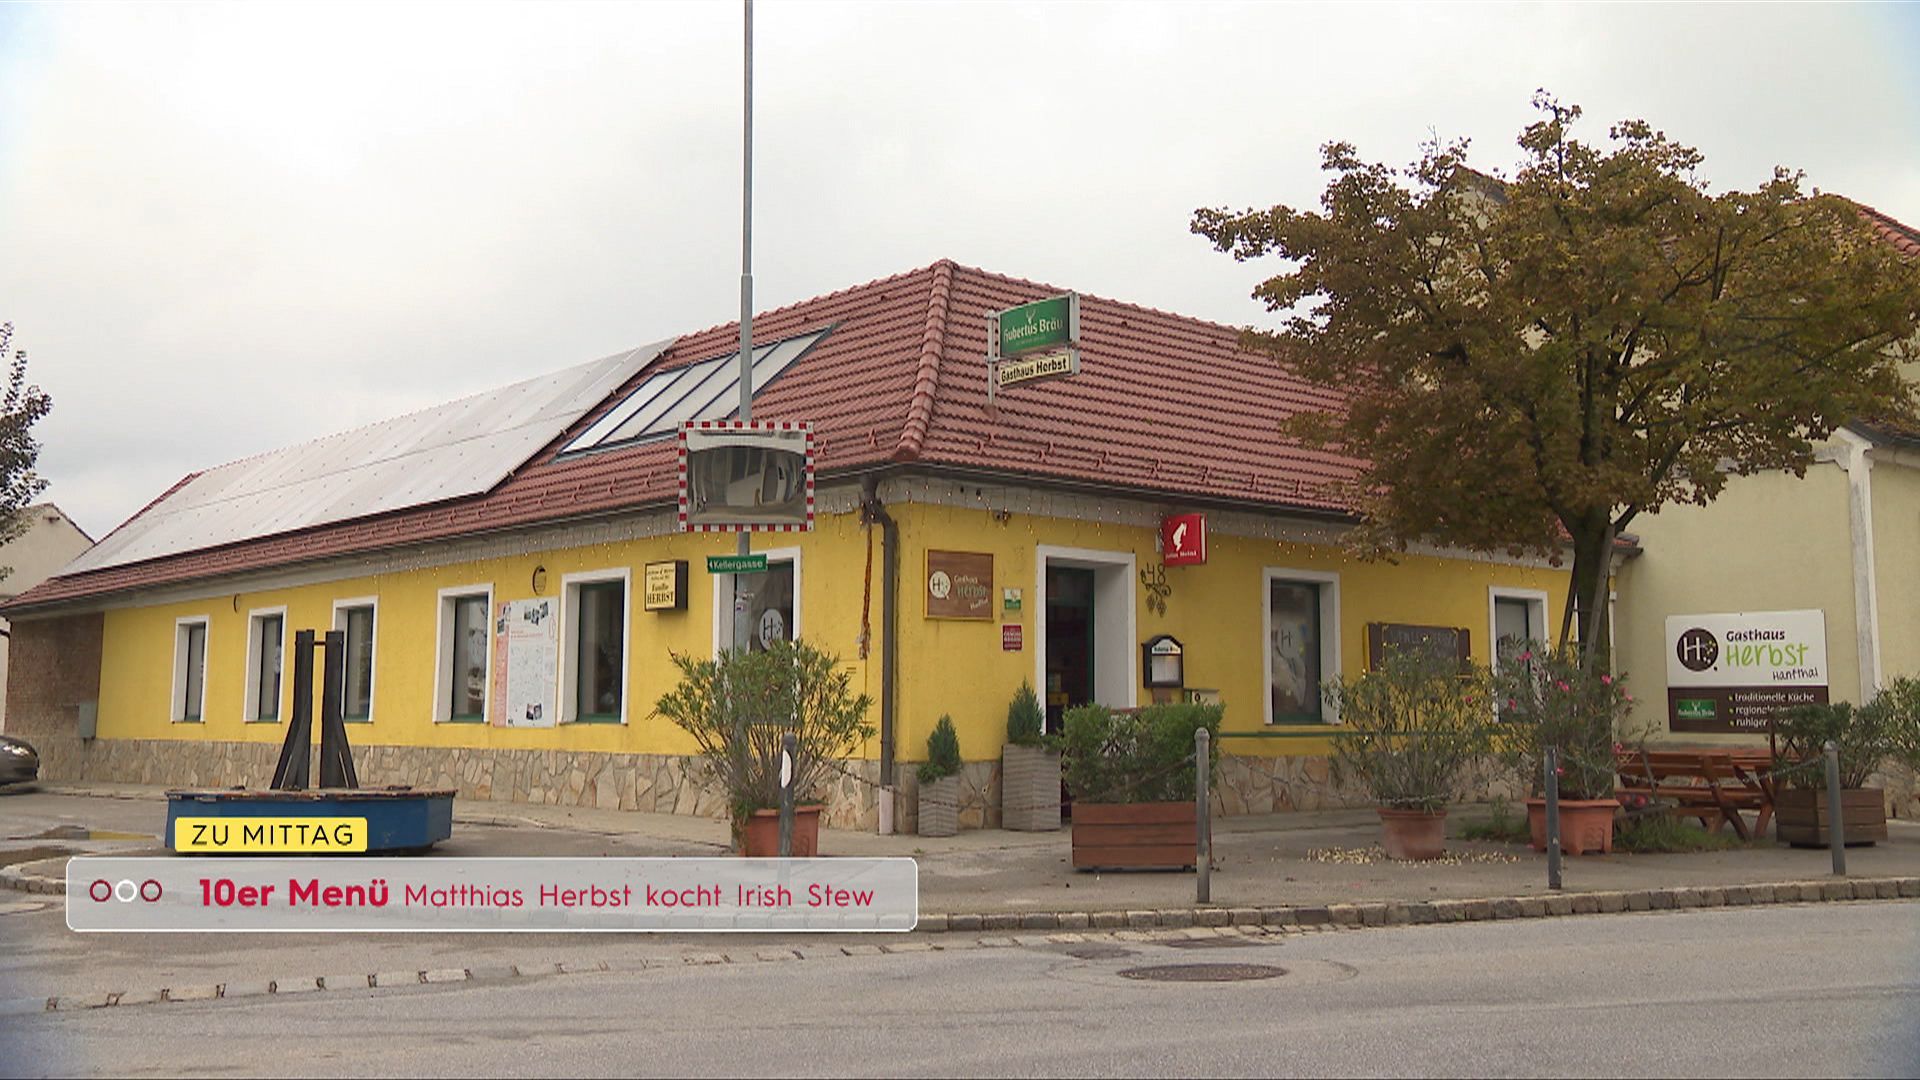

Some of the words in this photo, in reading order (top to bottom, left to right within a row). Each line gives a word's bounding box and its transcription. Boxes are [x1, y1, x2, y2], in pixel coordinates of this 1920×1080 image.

[1039, 317, 1063, 333] Bräu
[1001, 364, 1034, 383] Gasthaus
[1036, 357, 1067, 374] Herbst
[713, 558, 764, 570] Kellergasse
[1146, 562, 1166, 585] 48
[647, 591, 674, 605] HERBST
[1726, 628, 1786, 642] Gasthaus
[1726, 642, 1809, 667] Herbst
[1772, 667, 1819, 681] Hanfthal
[1734, 693, 1786, 703] traditionelle
[1736, 718, 1767, 728] ruhiger
